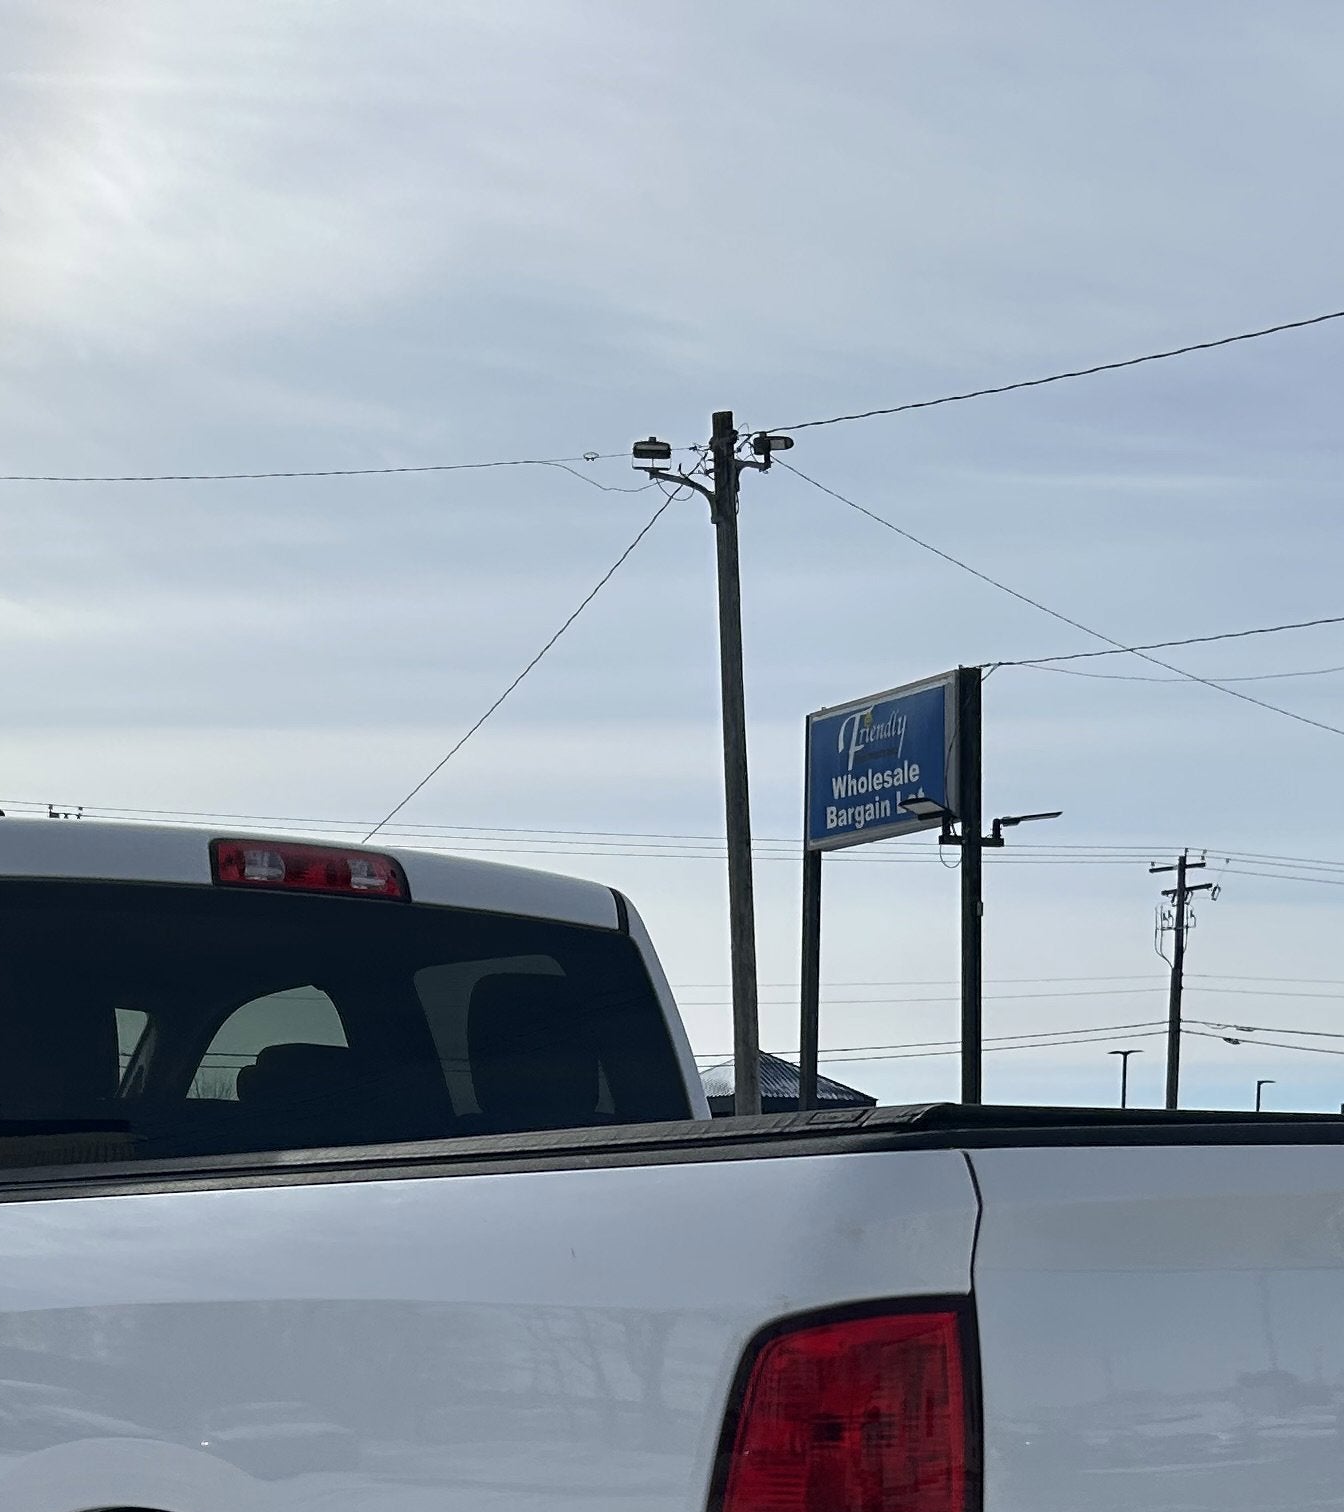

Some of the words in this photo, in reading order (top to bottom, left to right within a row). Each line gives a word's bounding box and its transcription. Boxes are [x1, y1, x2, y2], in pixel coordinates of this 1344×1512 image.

[837, 704, 907, 771] Friendly
[832, 760, 920, 800] Wholesale
[826, 798, 891, 830] Bargain
